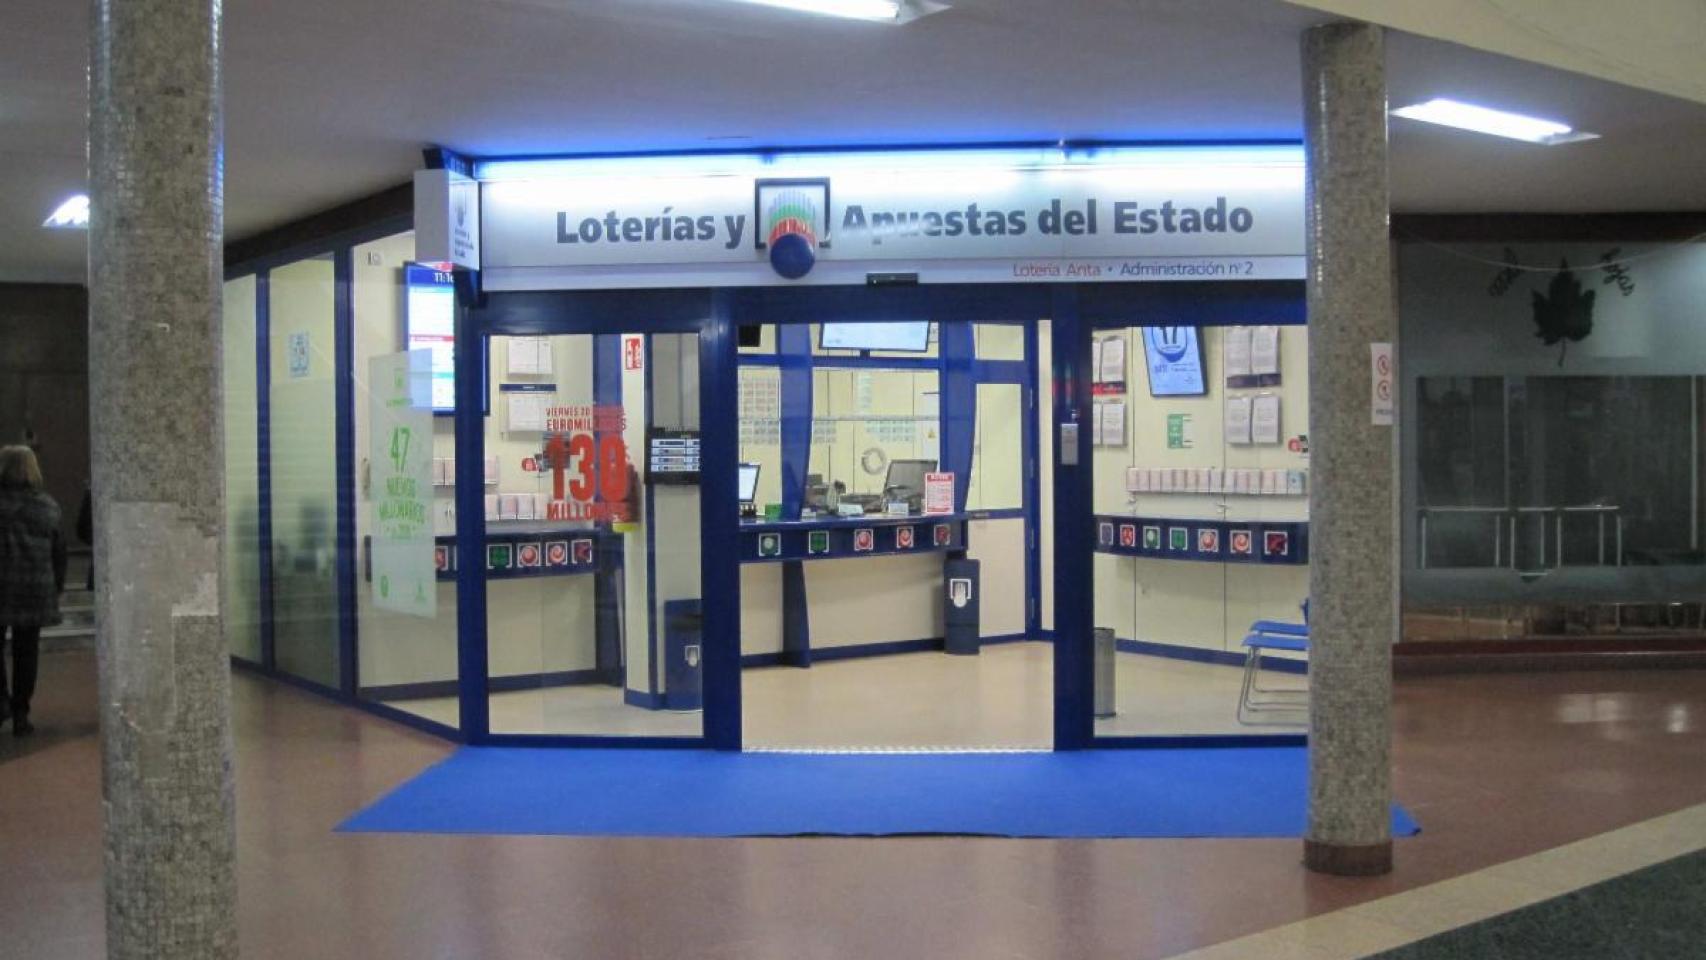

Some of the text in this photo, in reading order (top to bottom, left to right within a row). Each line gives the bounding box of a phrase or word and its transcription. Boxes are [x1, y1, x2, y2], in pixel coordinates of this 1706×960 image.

[556, 196, 1254, 250] Loterías y Apuestas del Estado
[390, 426, 411, 472] 47
[546, 433, 628, 502] 130
